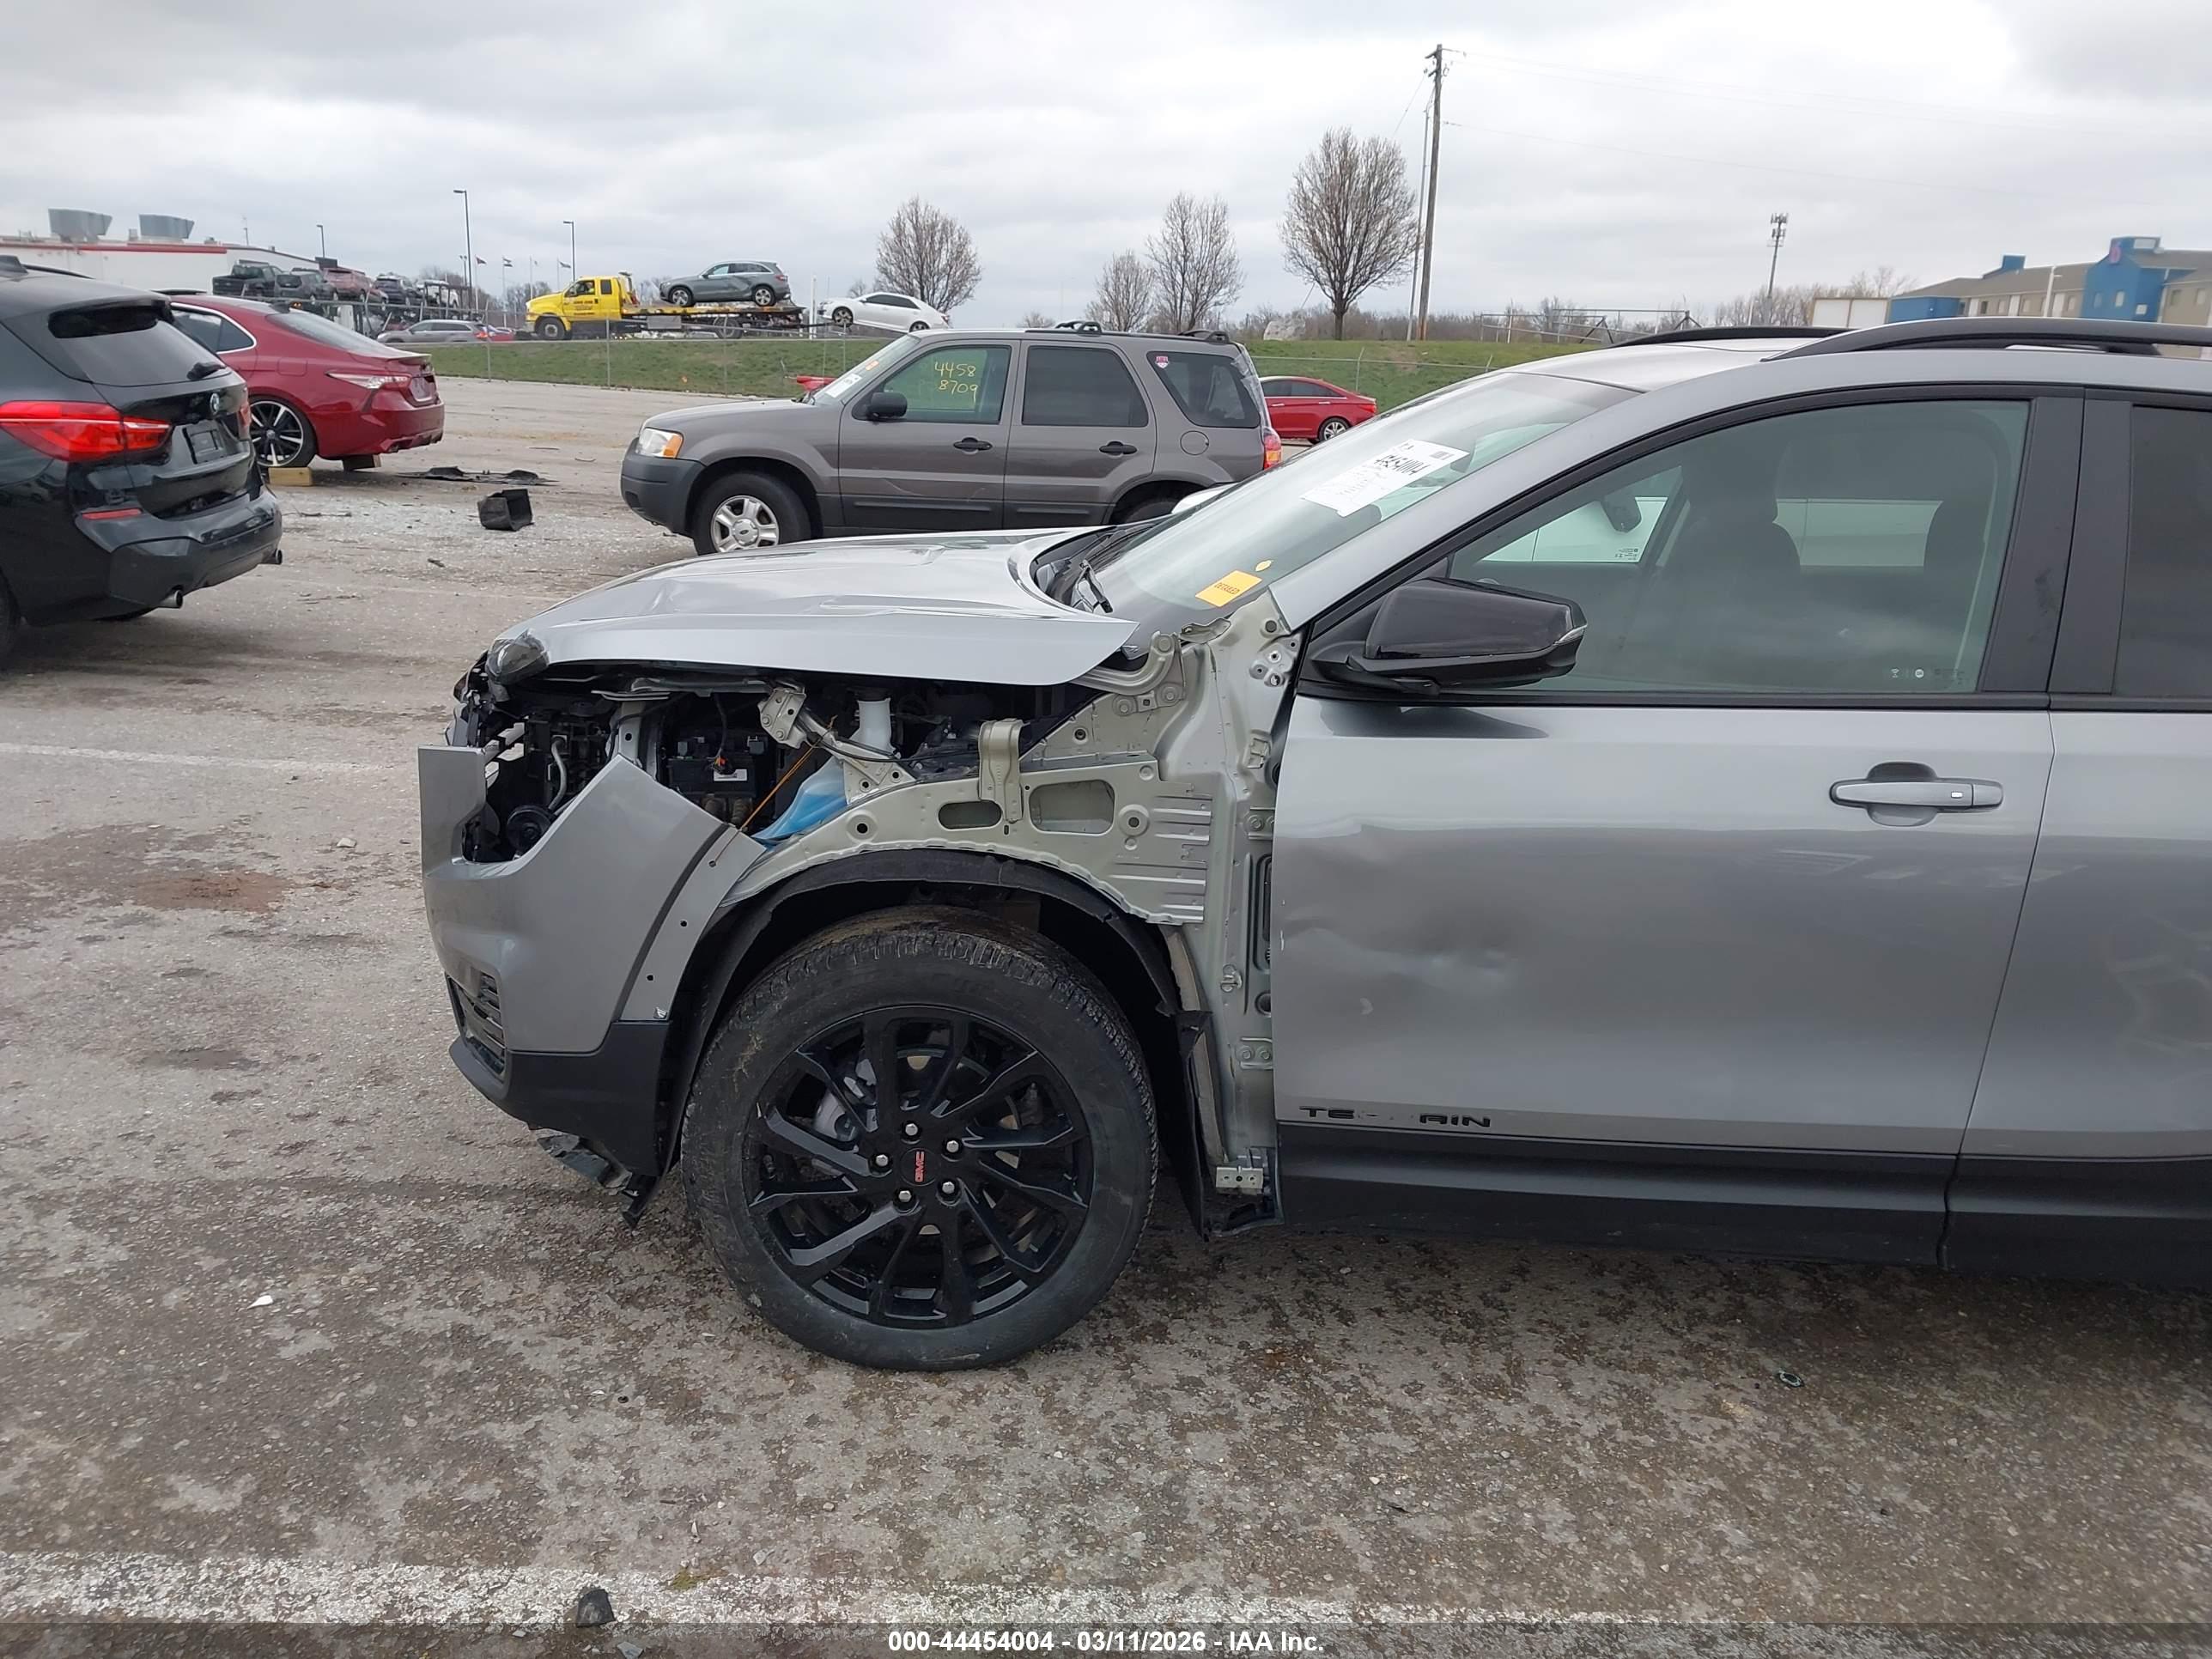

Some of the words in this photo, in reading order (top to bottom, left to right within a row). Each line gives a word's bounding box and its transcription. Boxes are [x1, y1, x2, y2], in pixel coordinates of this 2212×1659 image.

[935, 362, 976, 378] 4458
[939, 380, 979, 404] 8709
[915, 1151, 925, 1182] GMC
